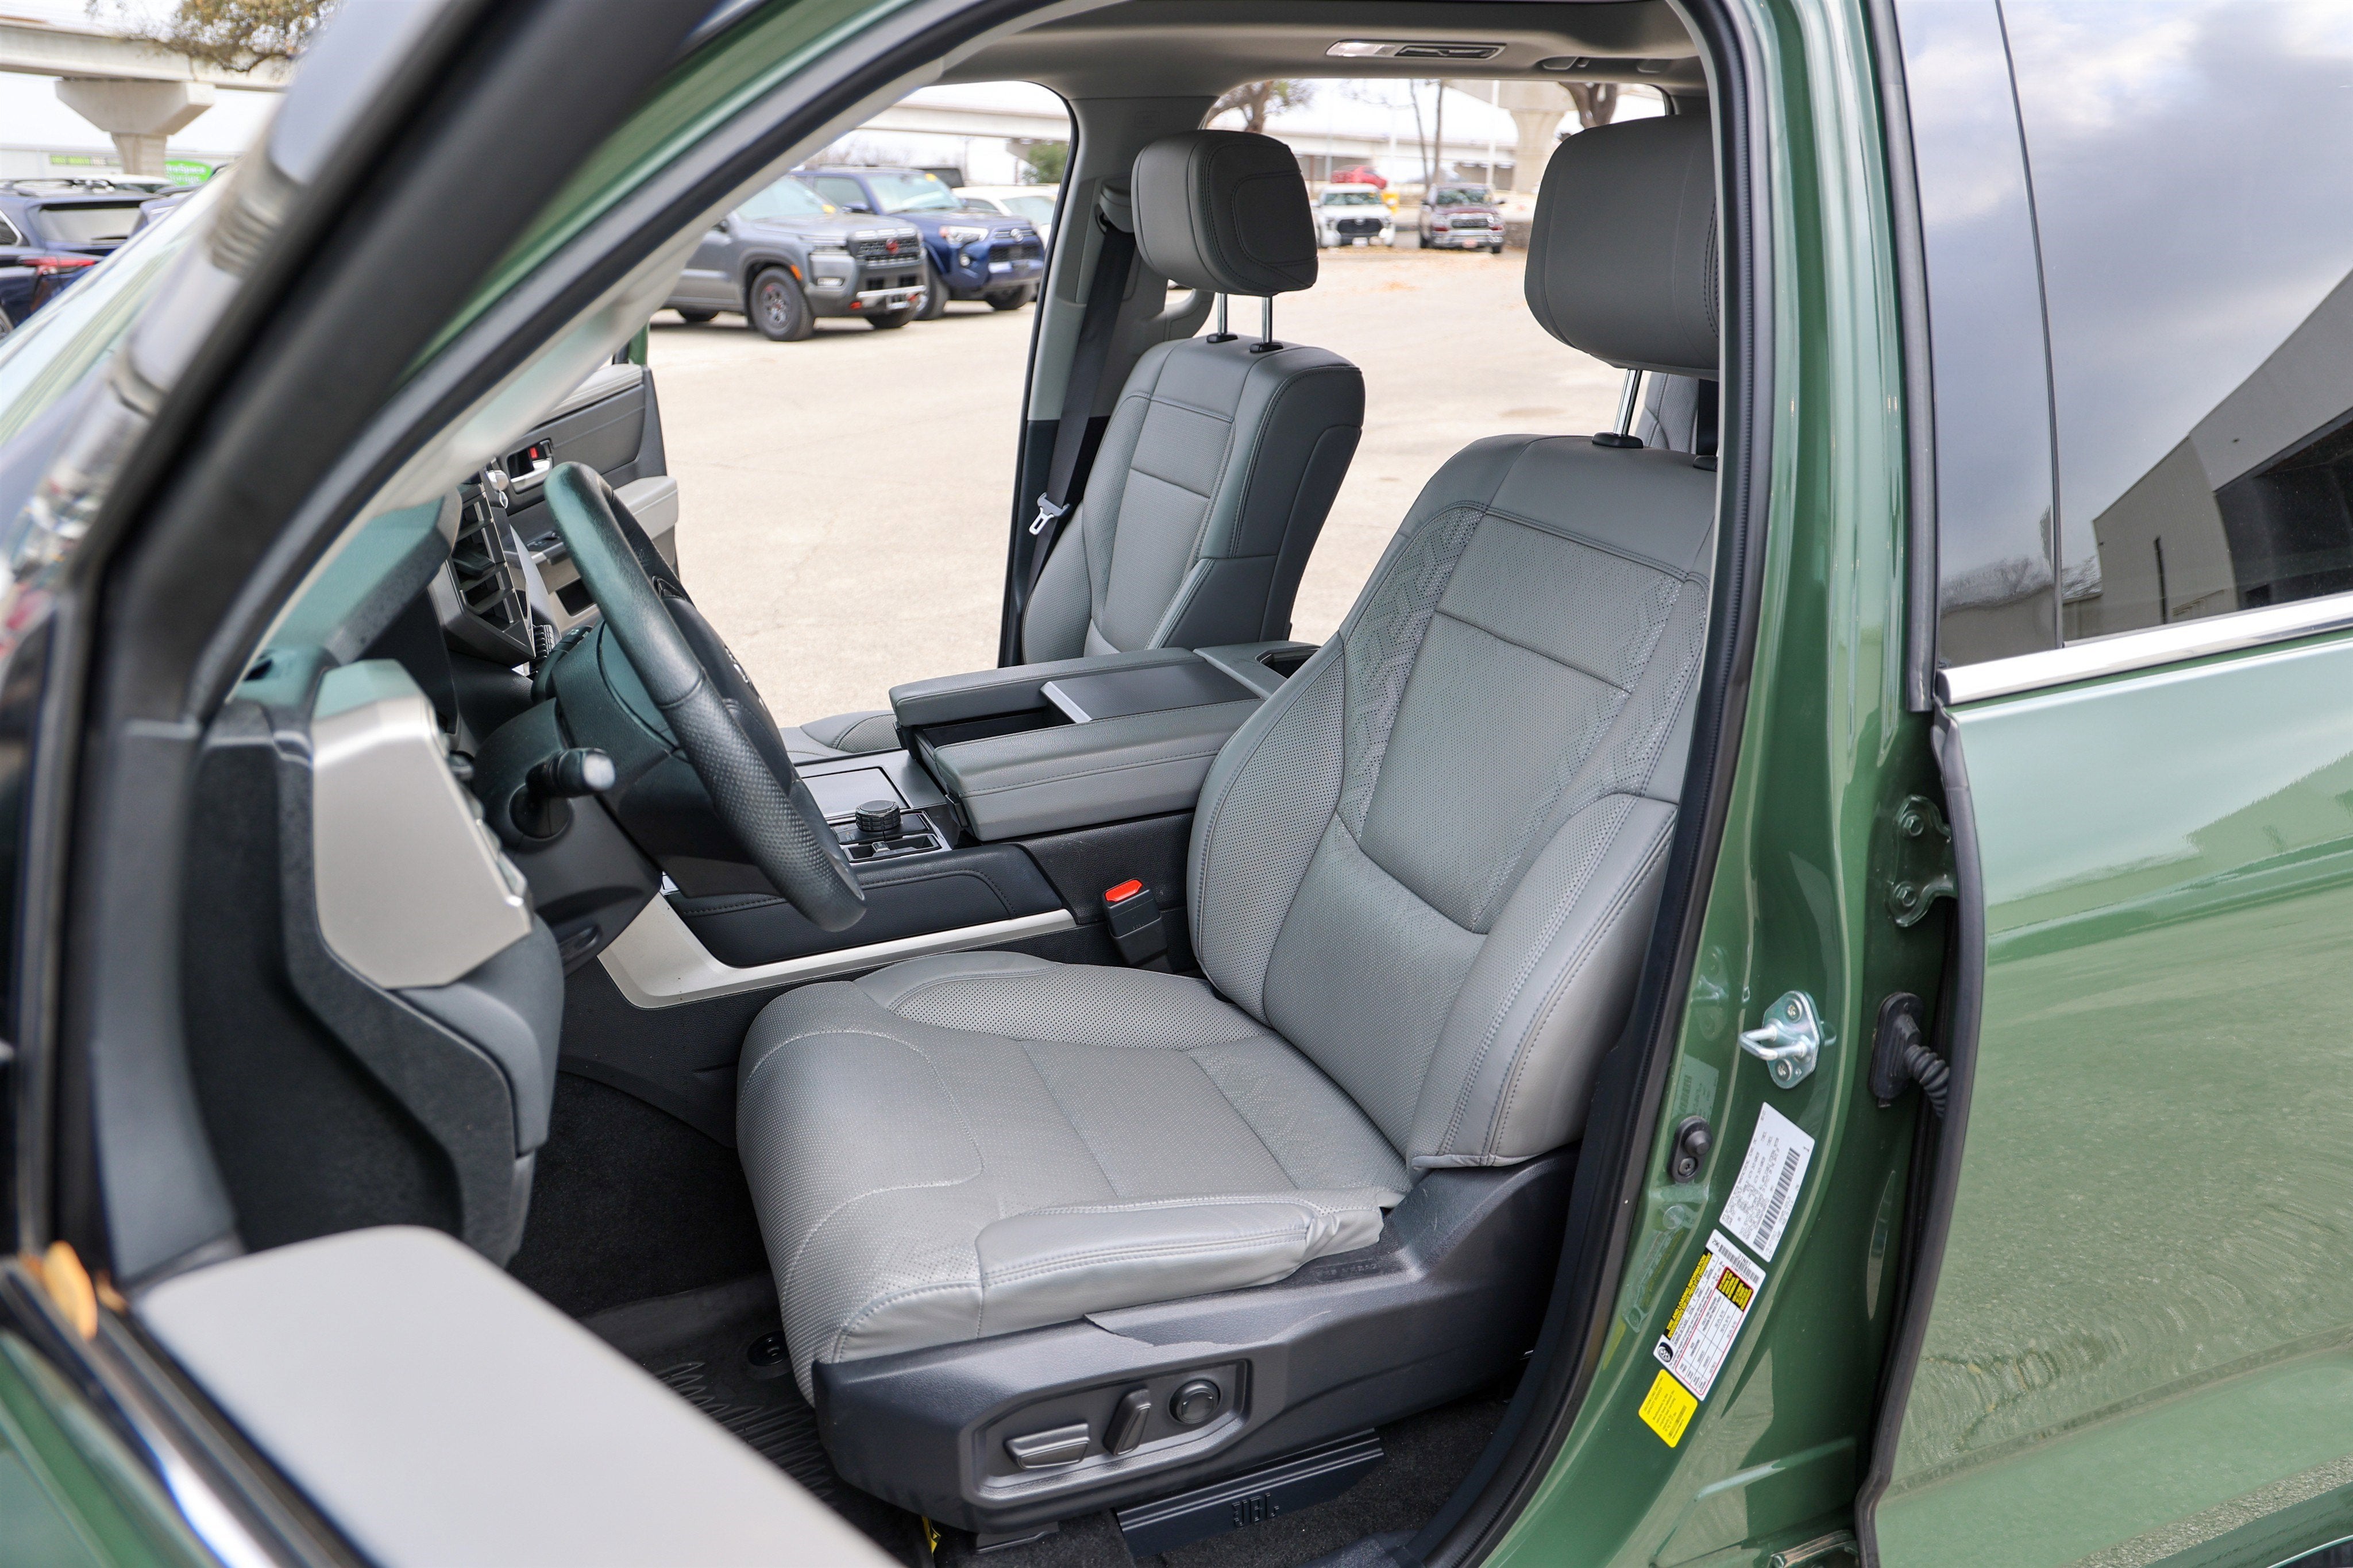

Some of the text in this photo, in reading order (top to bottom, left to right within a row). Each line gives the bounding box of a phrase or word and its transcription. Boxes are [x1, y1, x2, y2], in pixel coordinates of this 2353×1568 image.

[1712, 1238, 1721, 1248] 296
[1677, 1287, 1689, 1309] LOADING
[1687, 1253, 1706, 1288] INFORMATION
[1232, 1493, 1279, 1528] JBL
